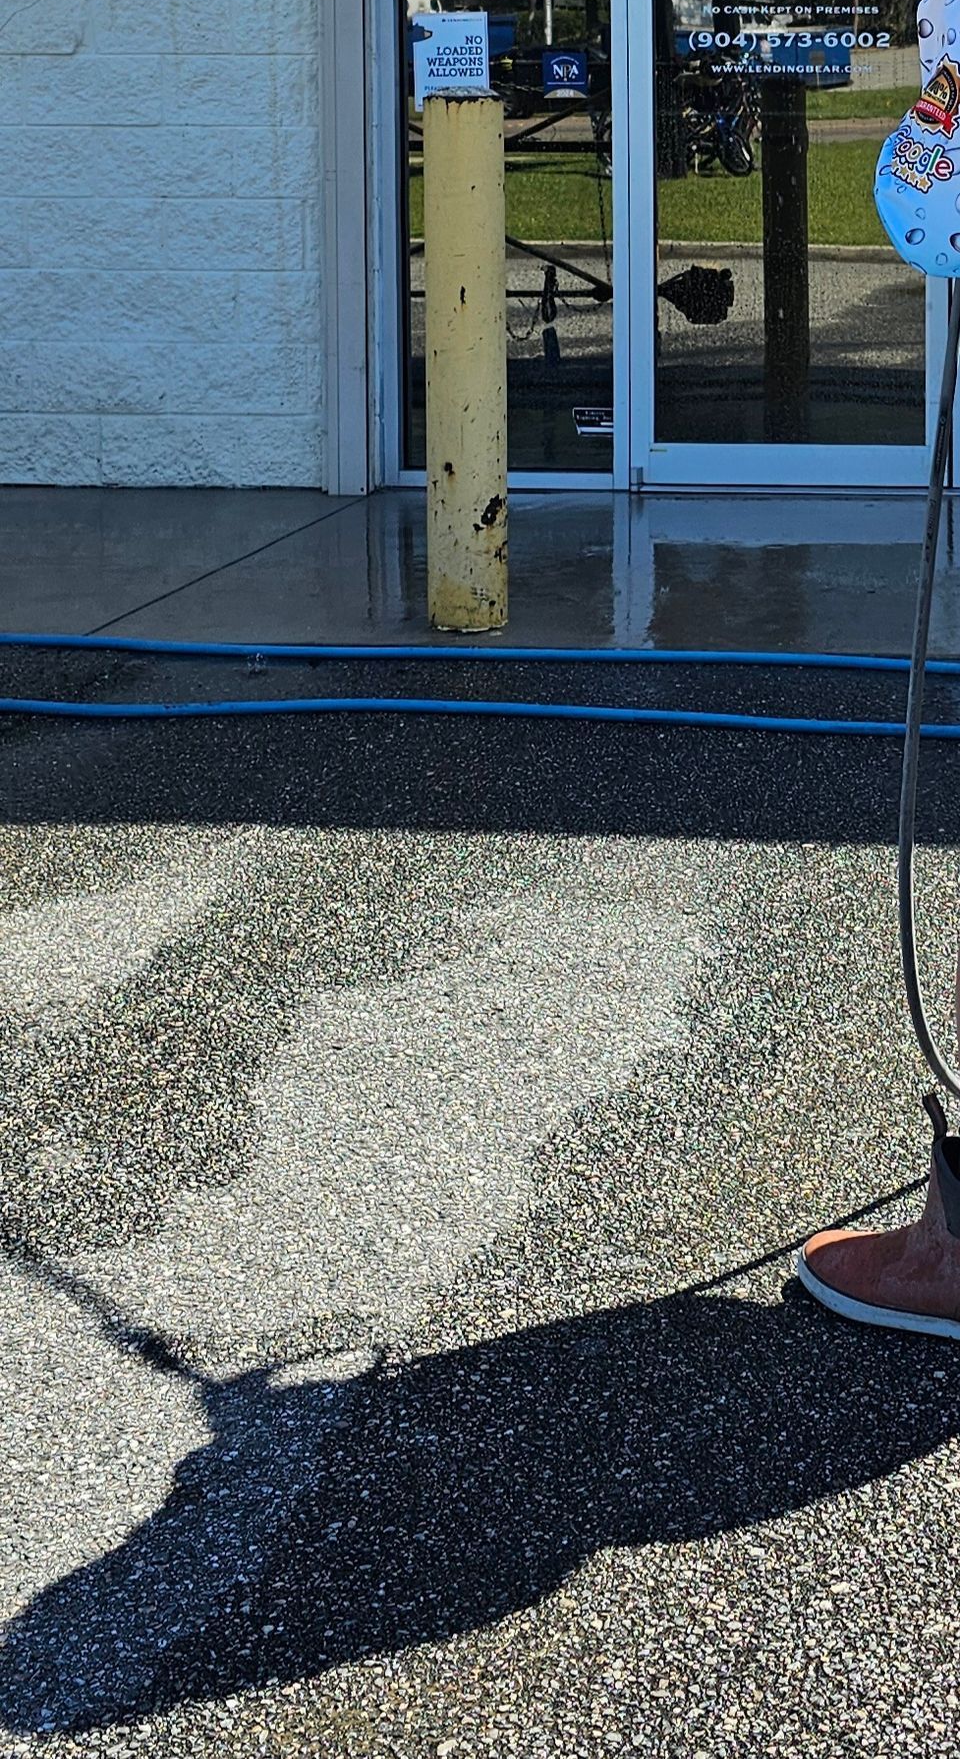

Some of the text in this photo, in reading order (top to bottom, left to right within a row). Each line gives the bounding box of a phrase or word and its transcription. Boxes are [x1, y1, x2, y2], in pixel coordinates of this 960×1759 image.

[703, 5, 720, 15] NO
[761, 5, 791, 15] KEPT
[795, 5, 812, 15] ON
[816, 5, 879, 15] PREMISES
[465, 35, 483, 45] NO
[688, 32, 891, 52] (904) 573-6002
[437, 46, 483, 56] LOADED
[427, 57, 483, 67] WEAPONS
[428, 67, 484, 78] ALLOWED
[553, 64, 579, 78] NPA
